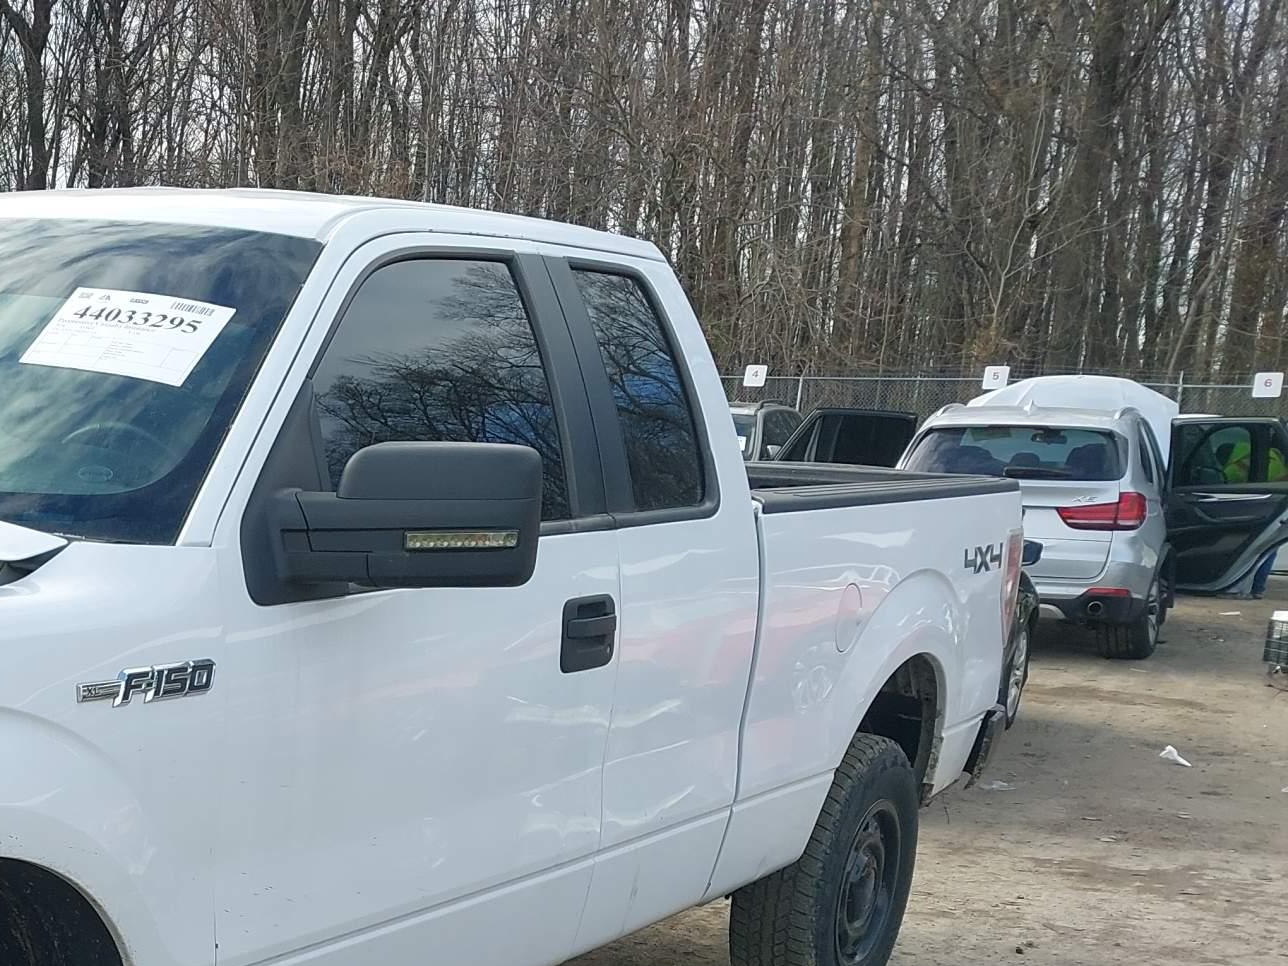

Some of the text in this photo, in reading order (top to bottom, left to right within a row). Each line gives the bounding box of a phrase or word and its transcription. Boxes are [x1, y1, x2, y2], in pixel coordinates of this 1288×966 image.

[73, 304, 202, 335] 44033295
[752, 369, 759, 378] 4
[992, 370, 1000, 380] 5
[1263, 378, 1273, 388] 6
[964, 542, 1003, 574] 4X4
